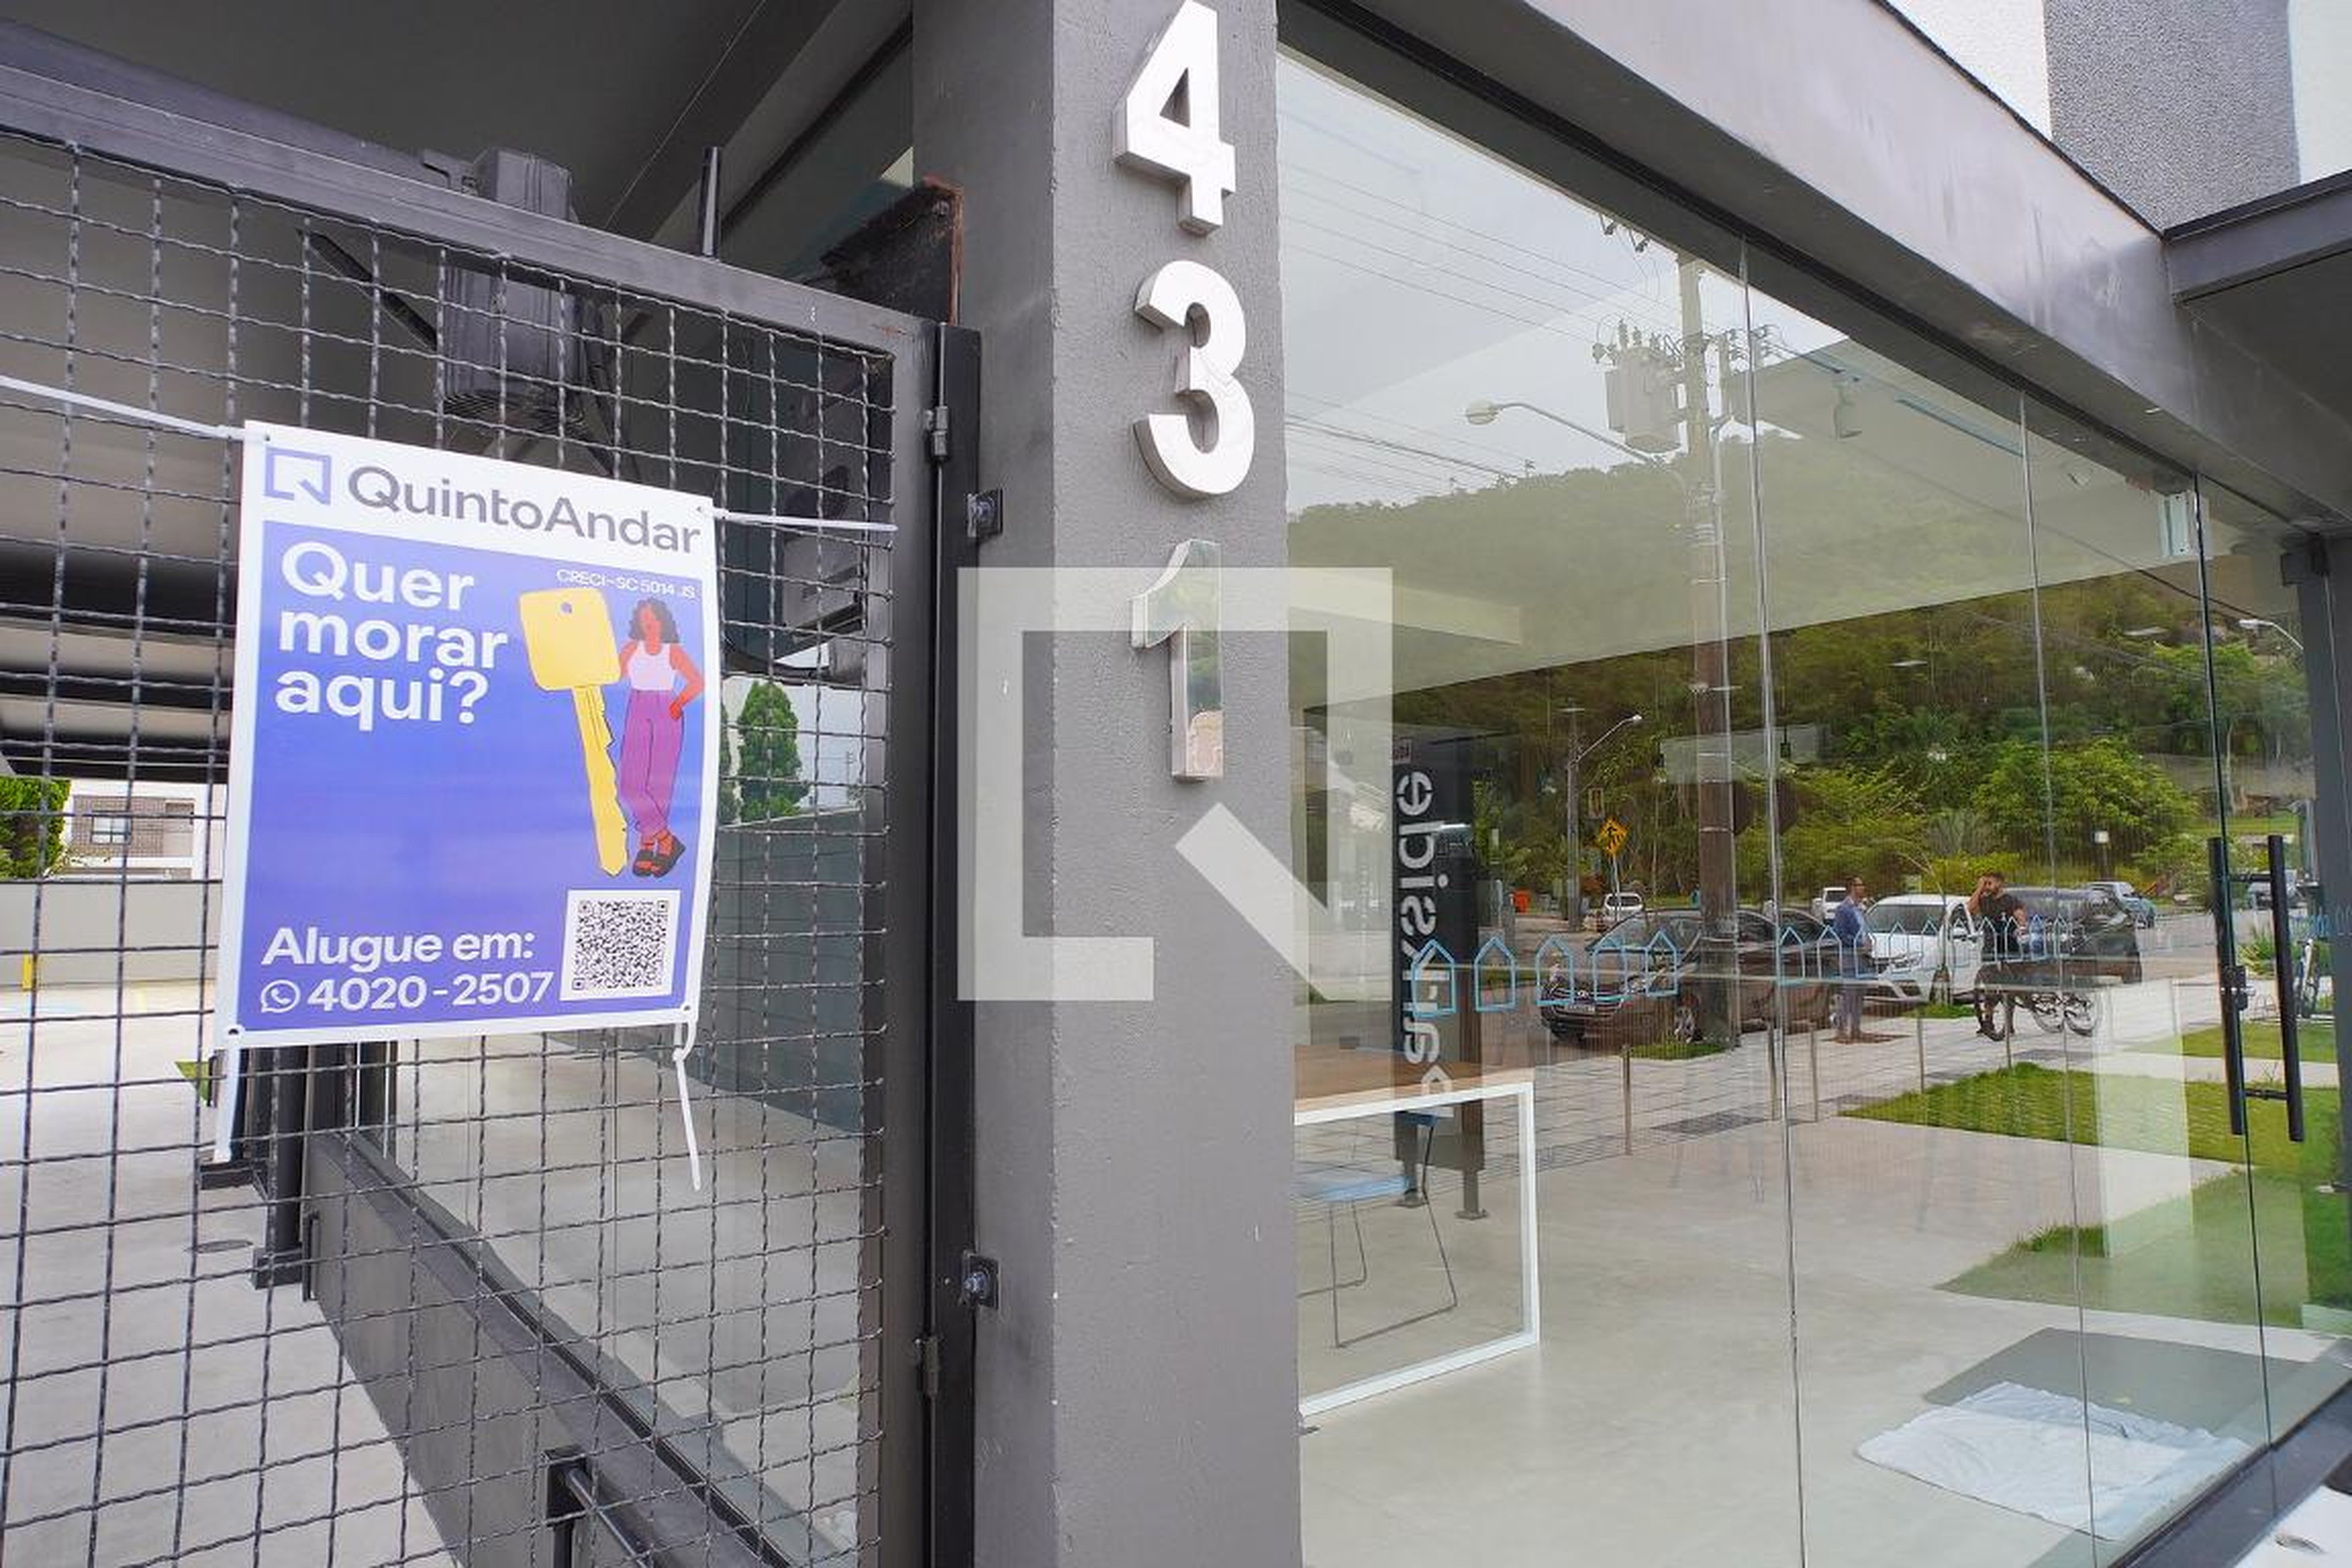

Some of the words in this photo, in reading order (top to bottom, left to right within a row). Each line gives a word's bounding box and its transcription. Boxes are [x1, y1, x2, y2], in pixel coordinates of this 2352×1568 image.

[348, 466, 701, 554] QuintoAndar
[281, 541, 475, 609] Quer
[641, 580, 674, 595] 5014
[279, 610, 508, 669] morar
[275, 668, 489, 731] aqui?
[260, 927, 442, 973] Alugue
[453, 932, 535, 961] em:
[307, 971, 554, 1012] 4020-2507
